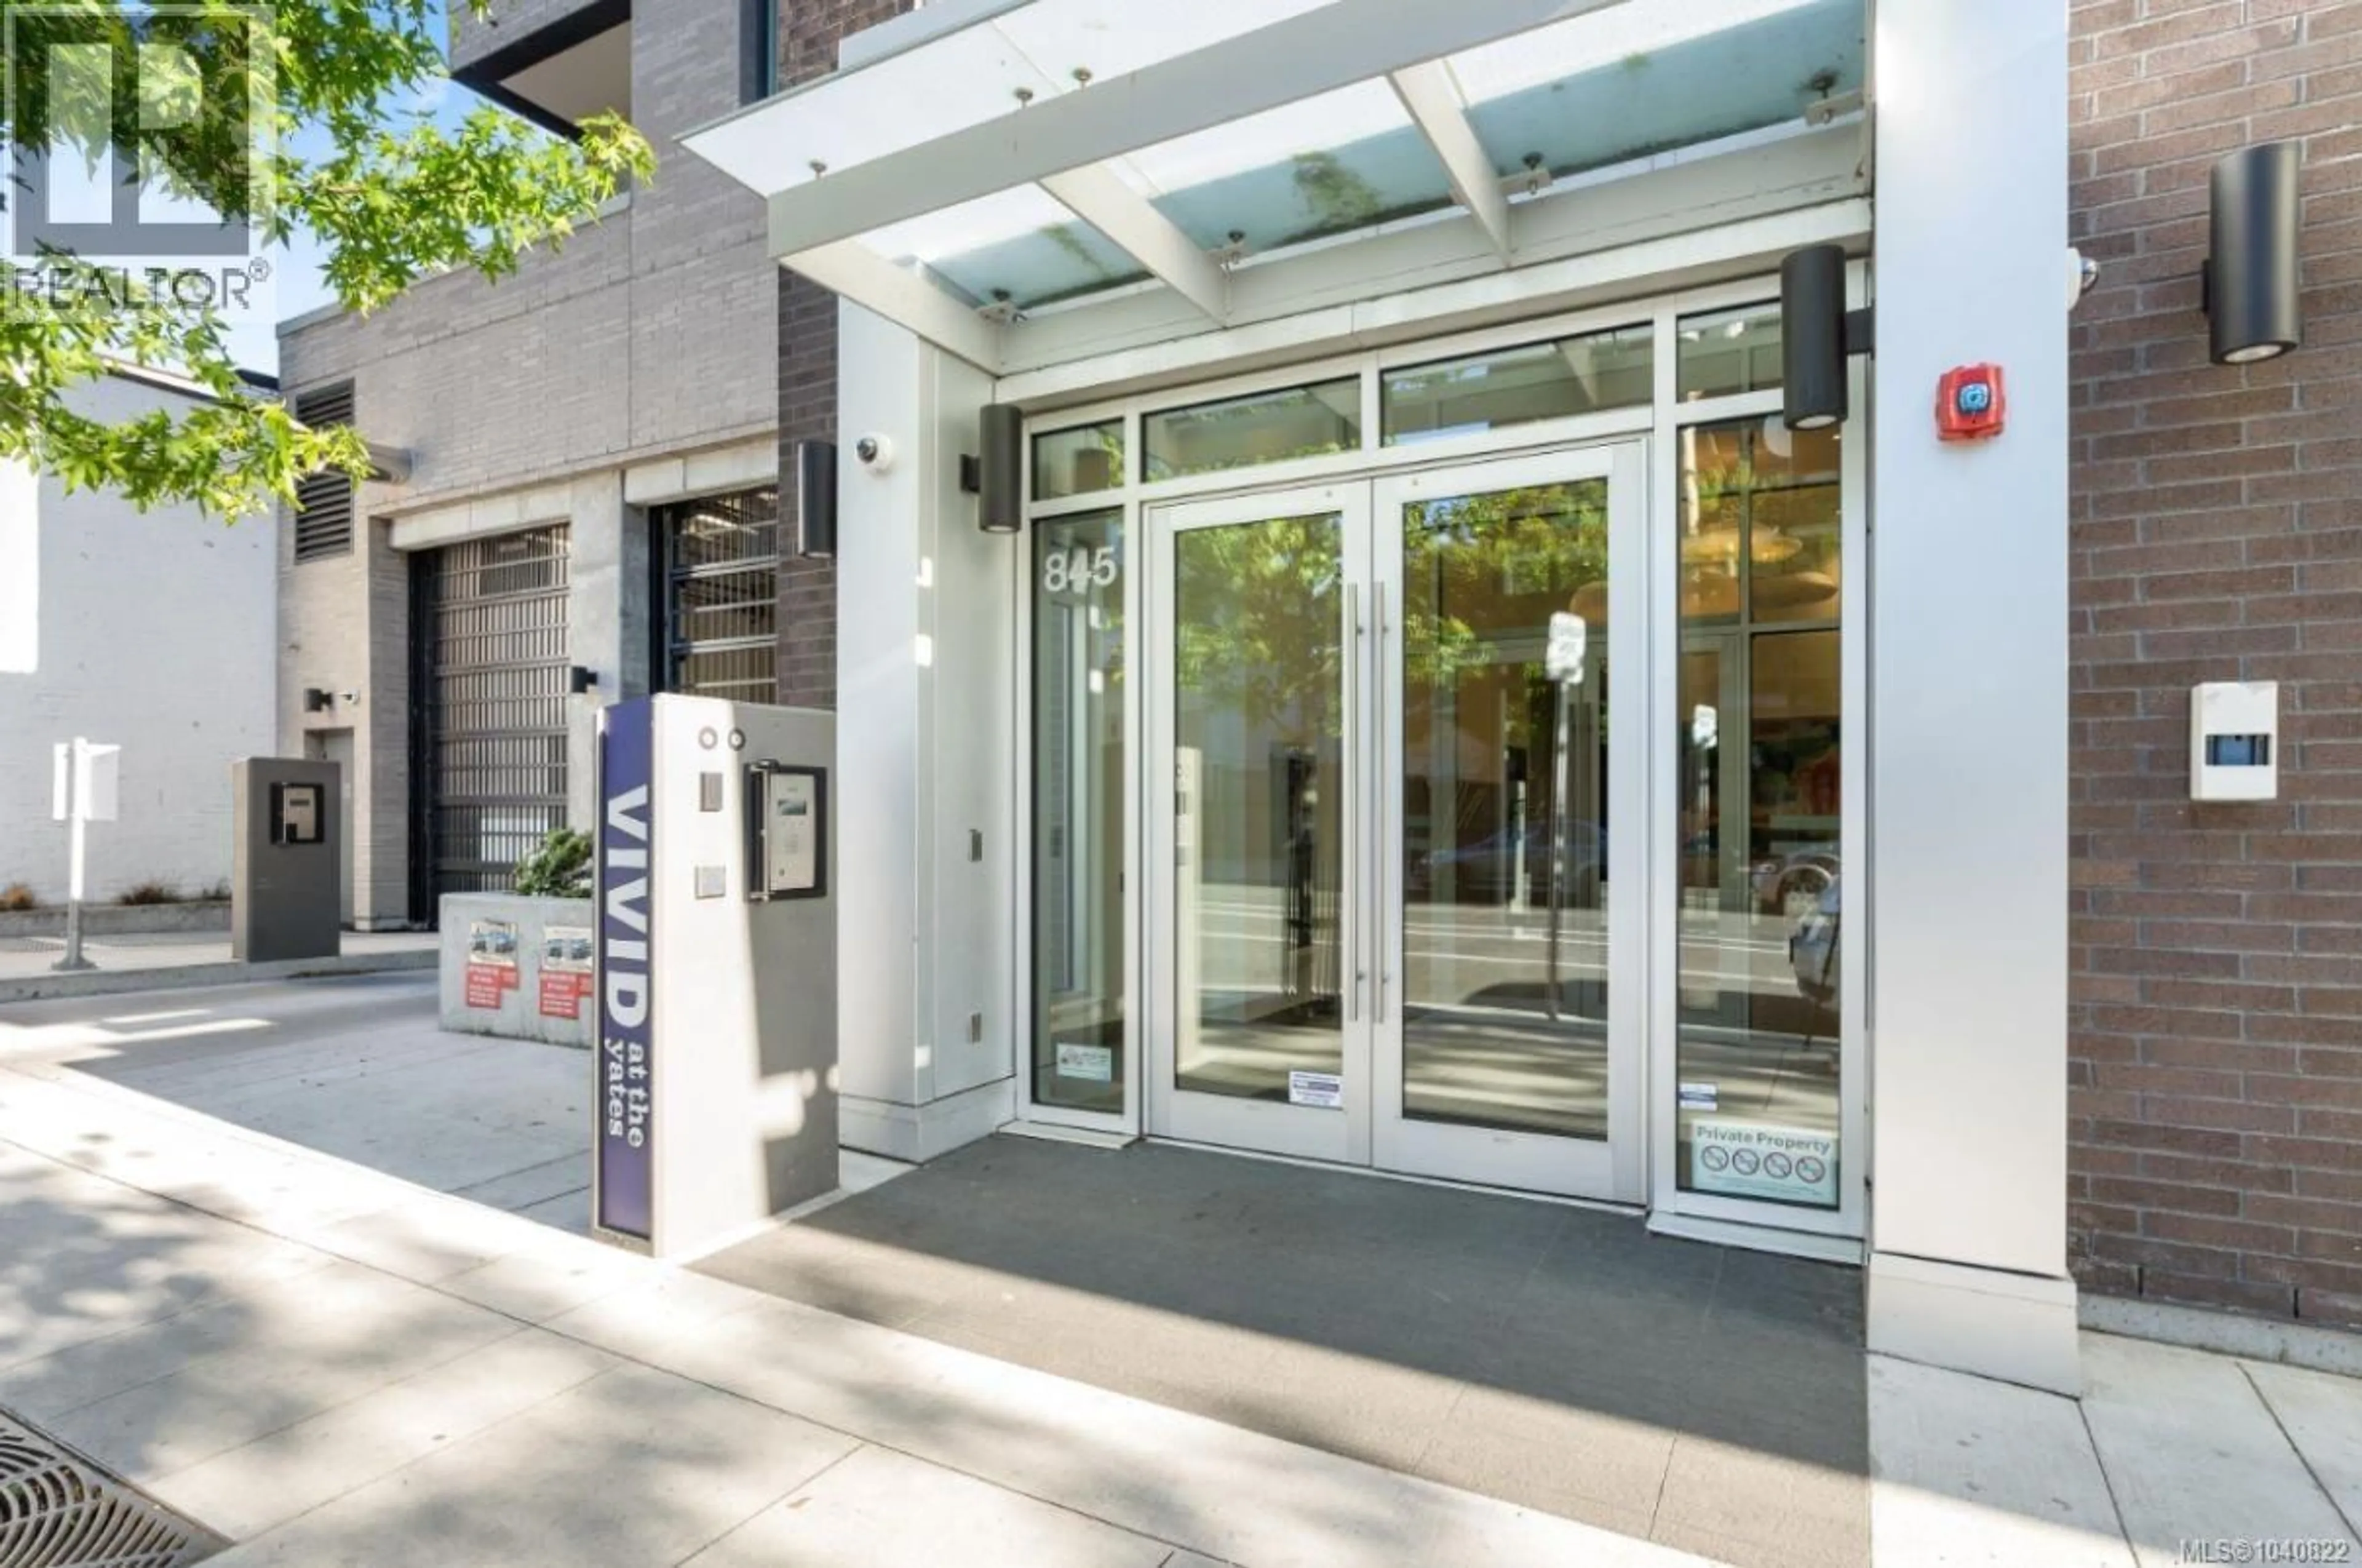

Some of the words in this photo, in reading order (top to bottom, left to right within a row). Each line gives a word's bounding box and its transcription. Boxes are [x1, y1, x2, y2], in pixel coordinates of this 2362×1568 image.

[1044, 547, 1117, 592] 845
[606, 783, 648, 1029] VIVID
[605, 1037, 624, 1137] yates
[627, 1042, 648, 1080] at
[627, 1084, 649, 1148] the
[1696, 1126, 1754, 1144] Private
[1756, 1132, 1831, 1156] Property
